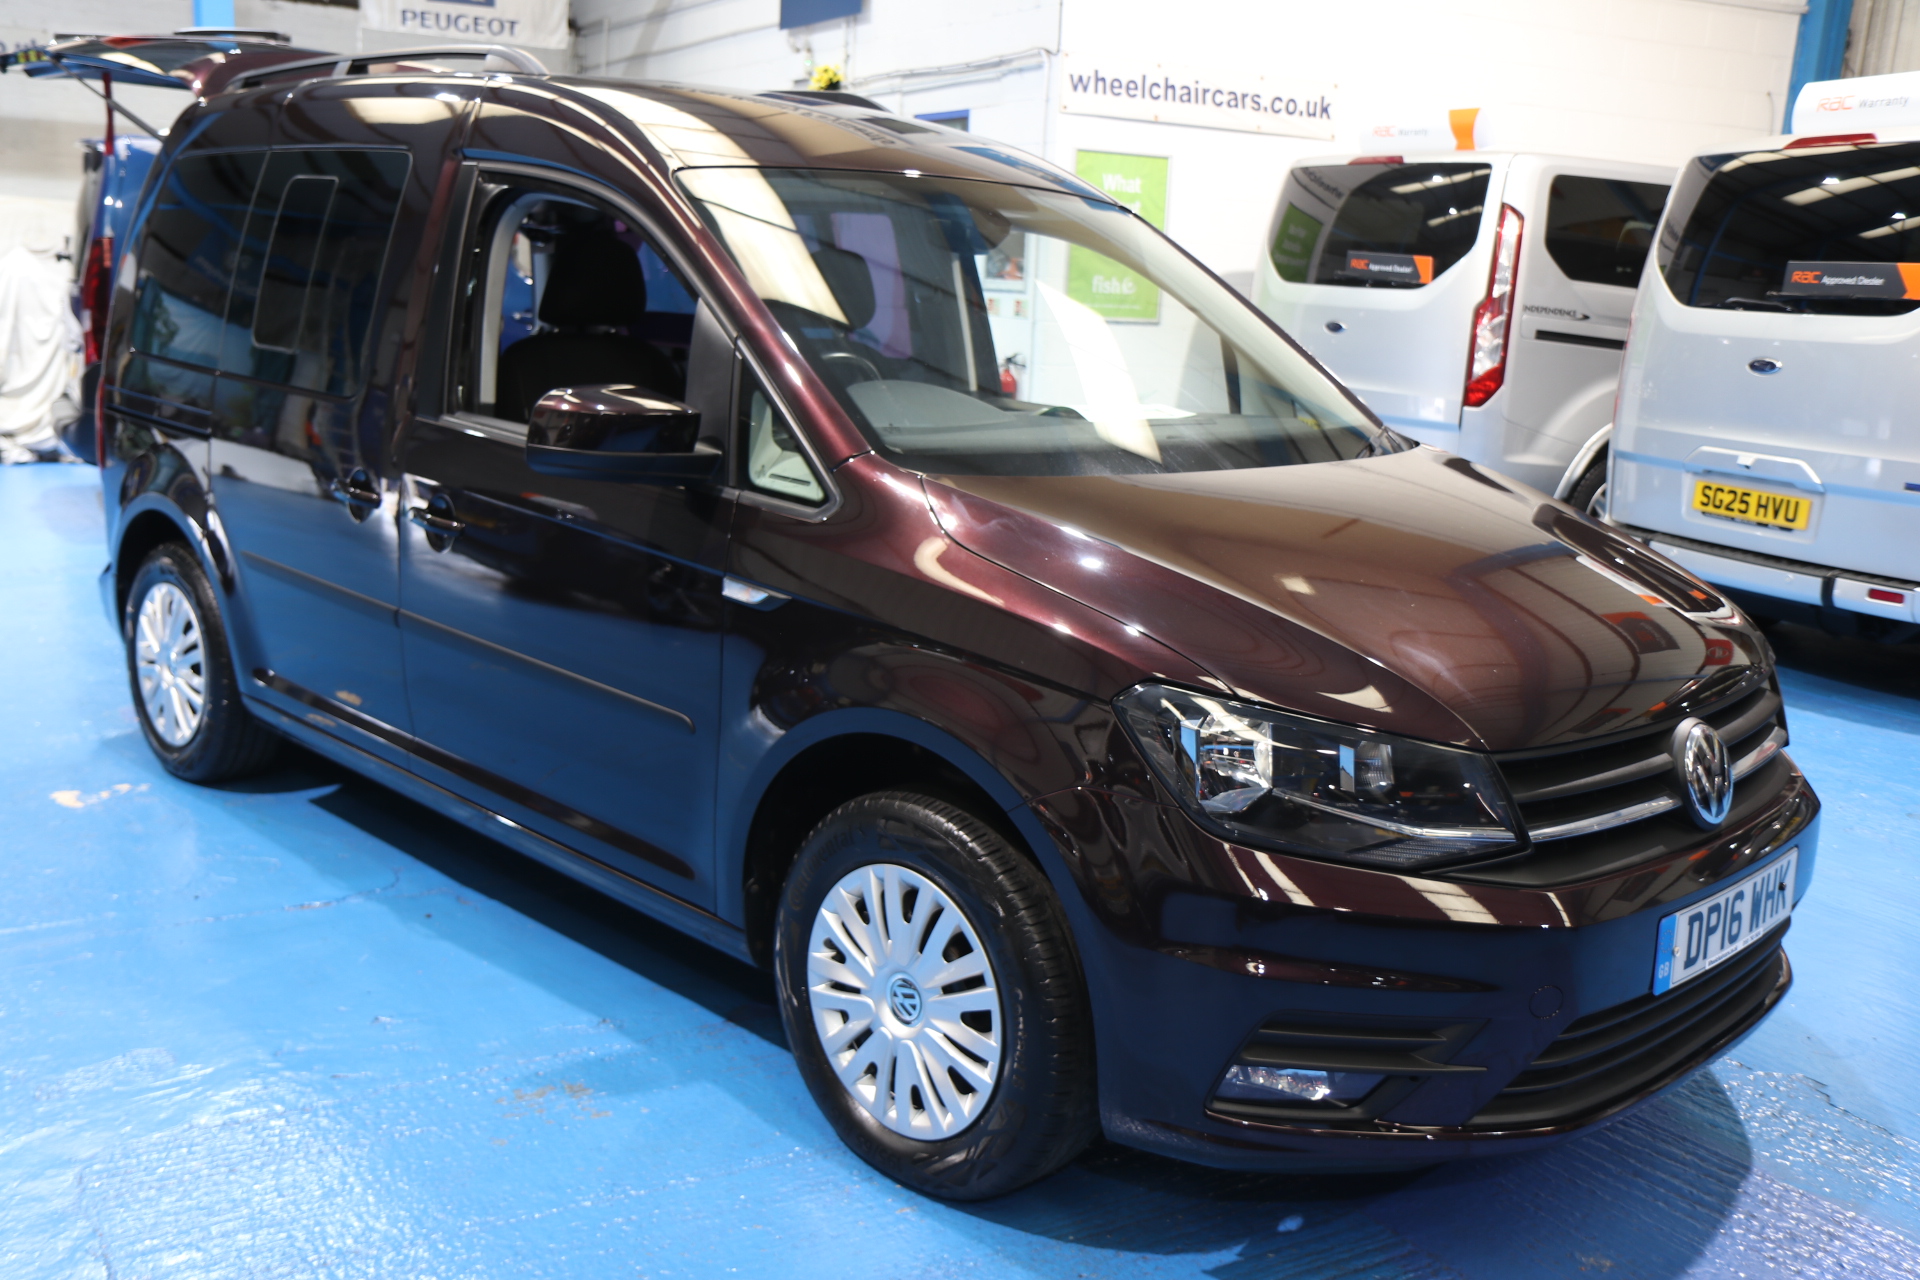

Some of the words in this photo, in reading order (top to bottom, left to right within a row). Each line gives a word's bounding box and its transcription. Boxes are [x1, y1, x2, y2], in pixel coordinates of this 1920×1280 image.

[402, 10, 519, 36] PEUGEOT
[1069, 69, 1331, 120] wheelchaircars.co.uk
[1102, 173, 1142, 194] What
[1700, 485, 1751, 514] SG25
[1755, 494, 1799, 523] HVU
[1683, 889, 1745, 971] DP16
[1749, 859, 1791, 933] WHK
